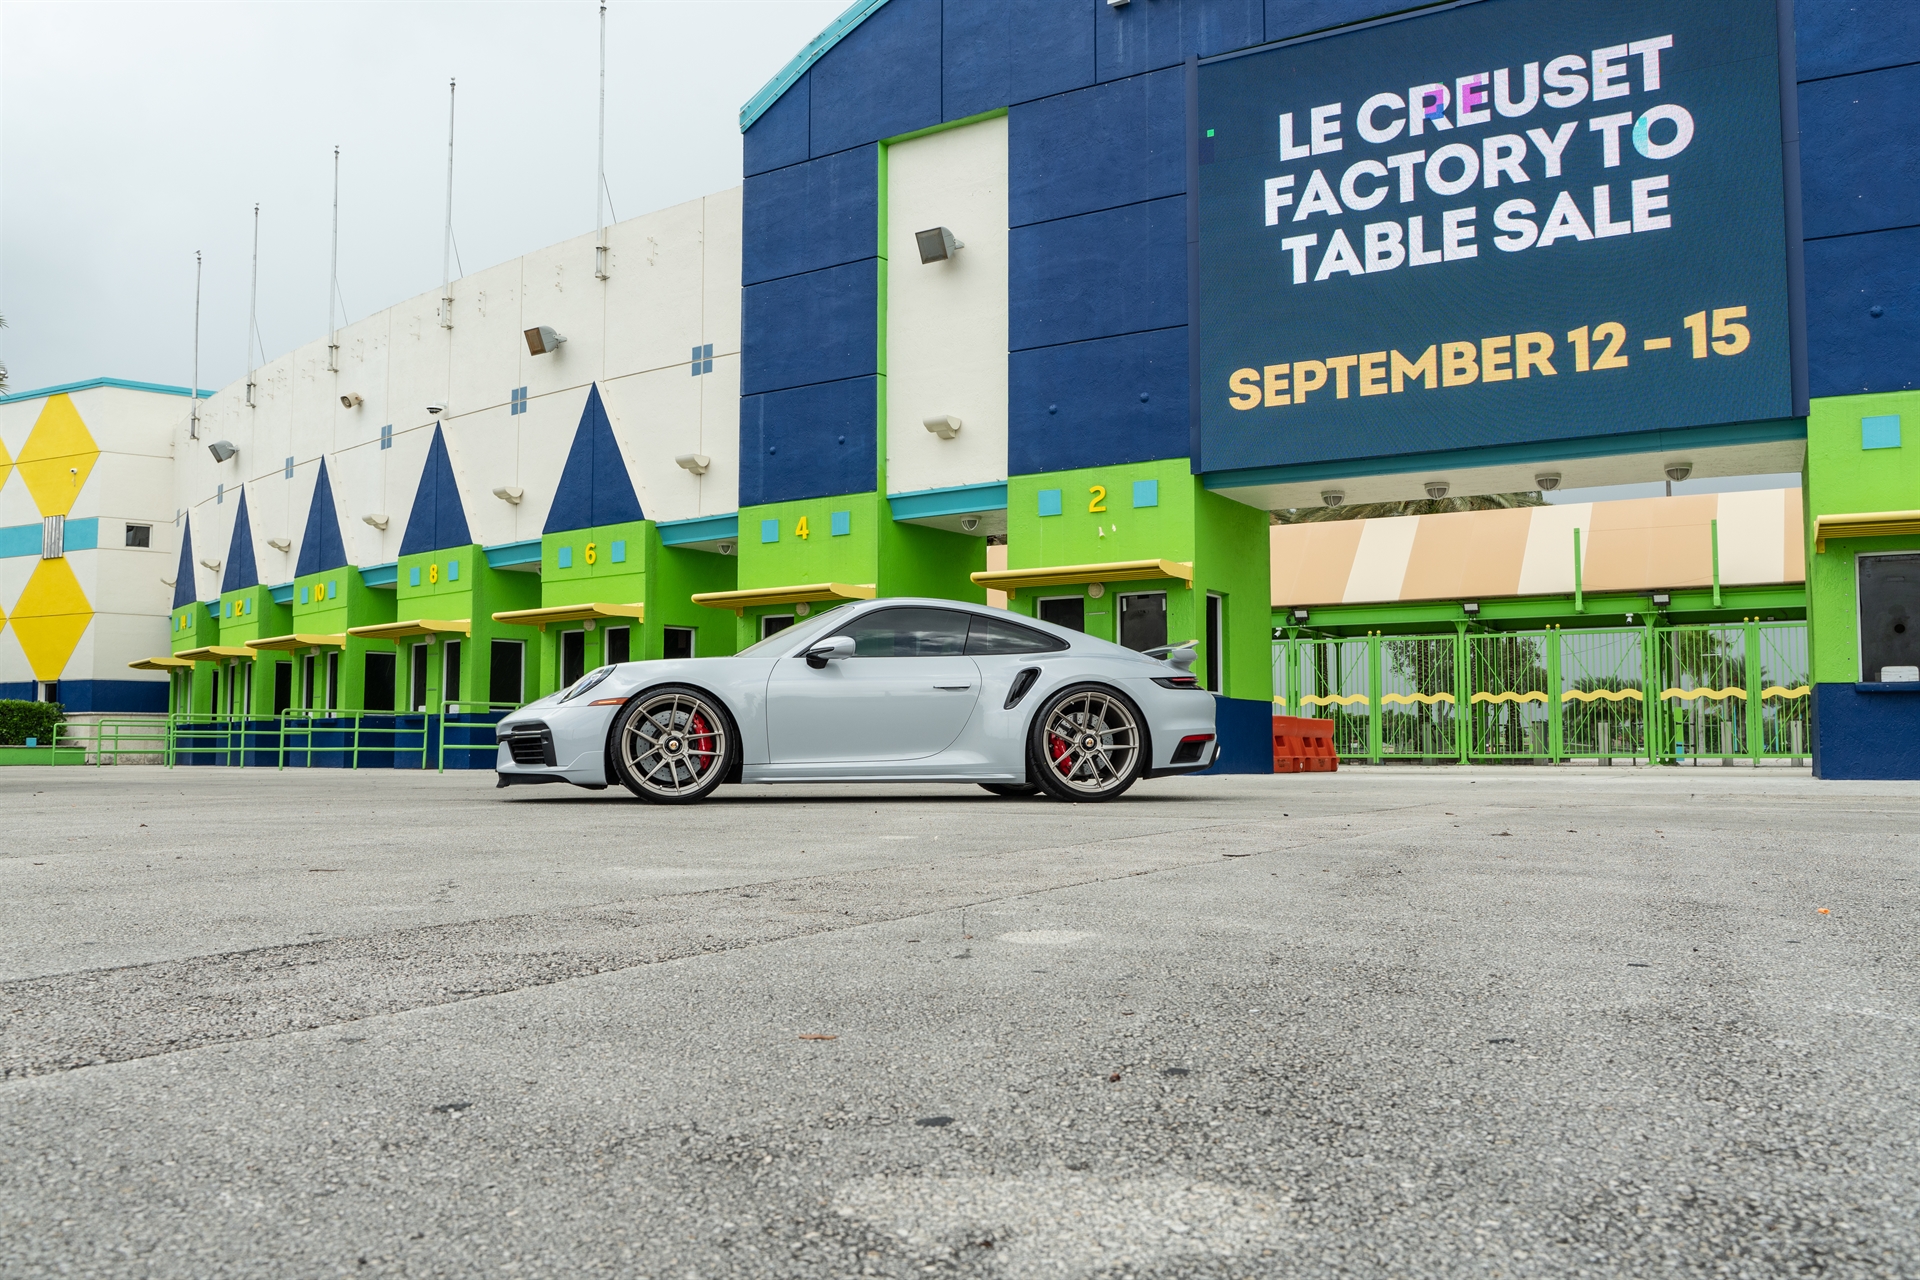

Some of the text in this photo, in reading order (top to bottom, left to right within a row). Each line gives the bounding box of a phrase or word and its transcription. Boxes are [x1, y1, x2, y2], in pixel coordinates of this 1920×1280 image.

[1279, 34, 1673, 162] LE CREUSET
[1264, 103, 1695, 227] FACTORY TO
[1281, 174, 1672, 285] TABLE SALE
[1228, 331, 1558, 411] SEPTEMBER
[1567, 321, 1629, 373] 12
[1683, 305, 1751, 359] 15
[1088, 485, 1107, 513] 2
[795, 516, 810, 540] 4
[584, 542, 597, 565] 6
[429, 563, 439, 584] 8
[314, 583, 325, 602] 10
